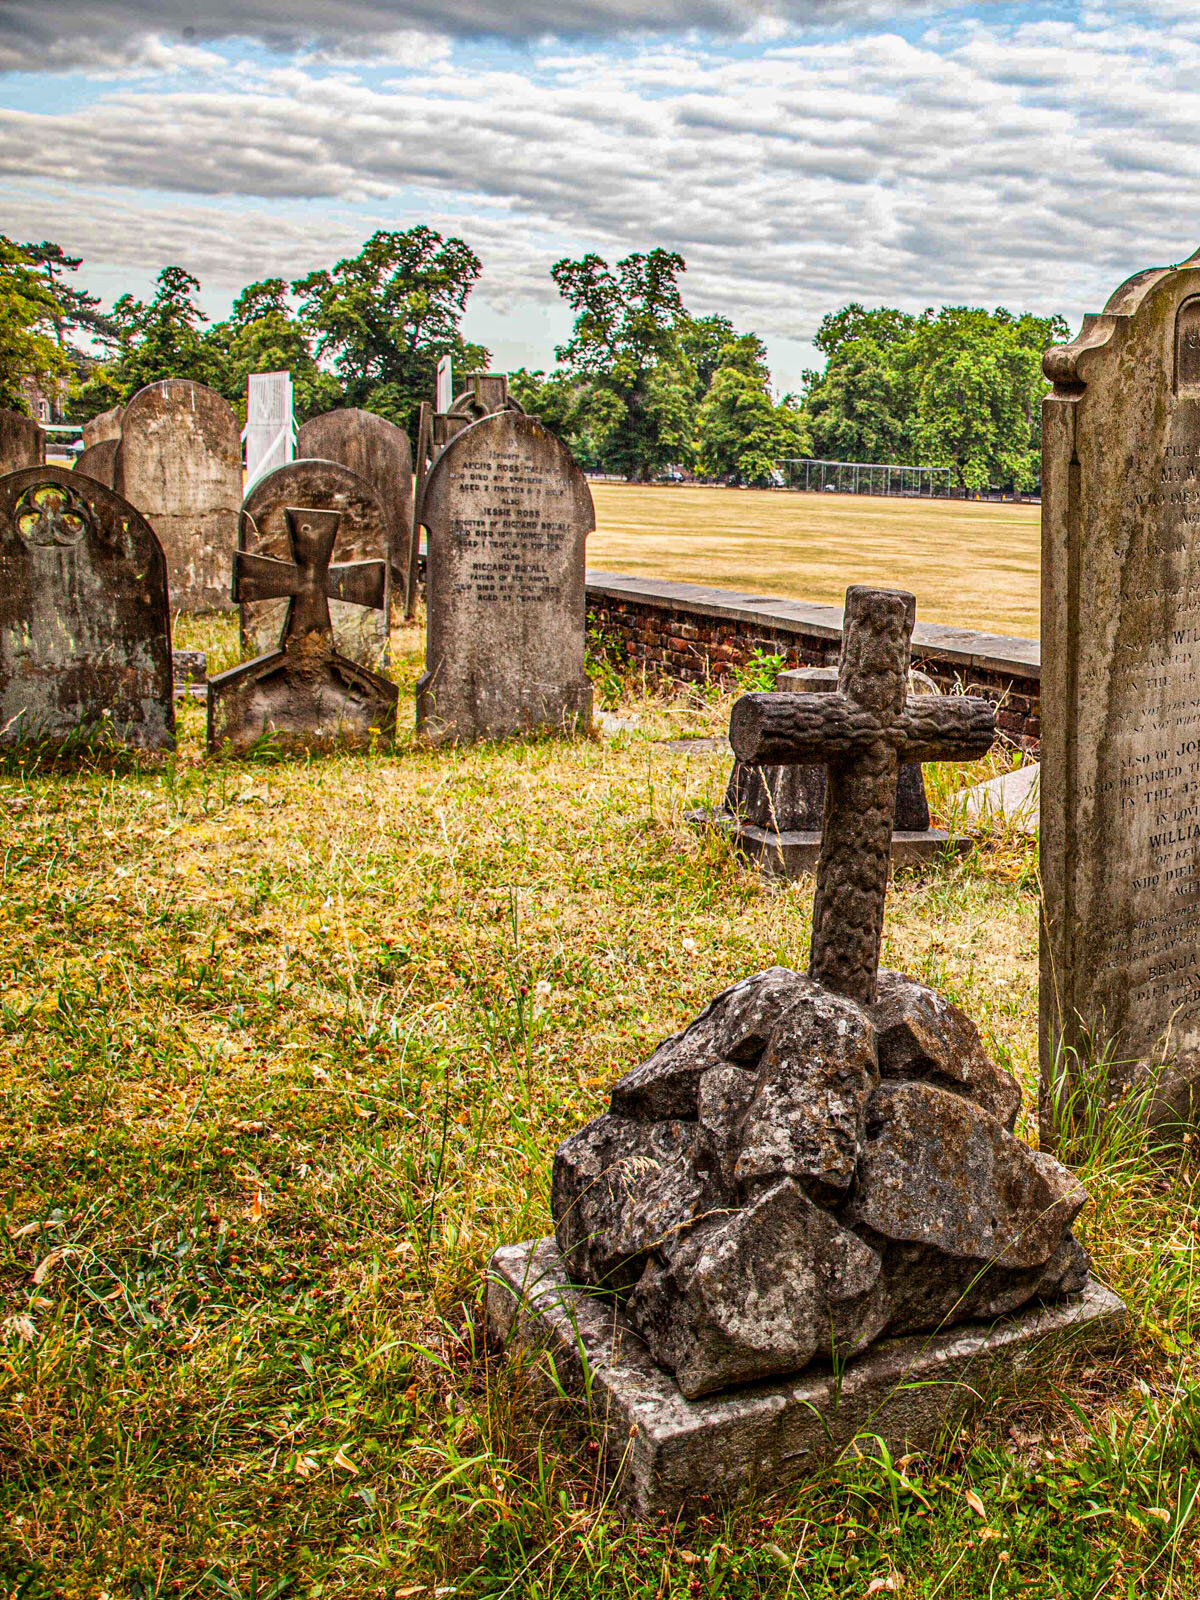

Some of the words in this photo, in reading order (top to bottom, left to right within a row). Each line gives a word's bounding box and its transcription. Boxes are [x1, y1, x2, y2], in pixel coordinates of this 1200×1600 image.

[497, 463, 520, 473] ROSS
[483, 507, 511, 517] JESSIE
[517, 509, 540, 518] ROSS
[1144, 675, 1172, 691] THE
[1156, 749, 1172, 762] OF
[1119, 766, 1183, 790] DEPARTED
[1143, 785, 1173, 805] THE
[1156, 812, 1169, 827] IN
[1155, 852, 1172, 866] OF
[1131, 873, 1161, 890] WHO
[1164, 863, 1196, 882] DIED
[1136, 984, 1170, 1001] DIED
